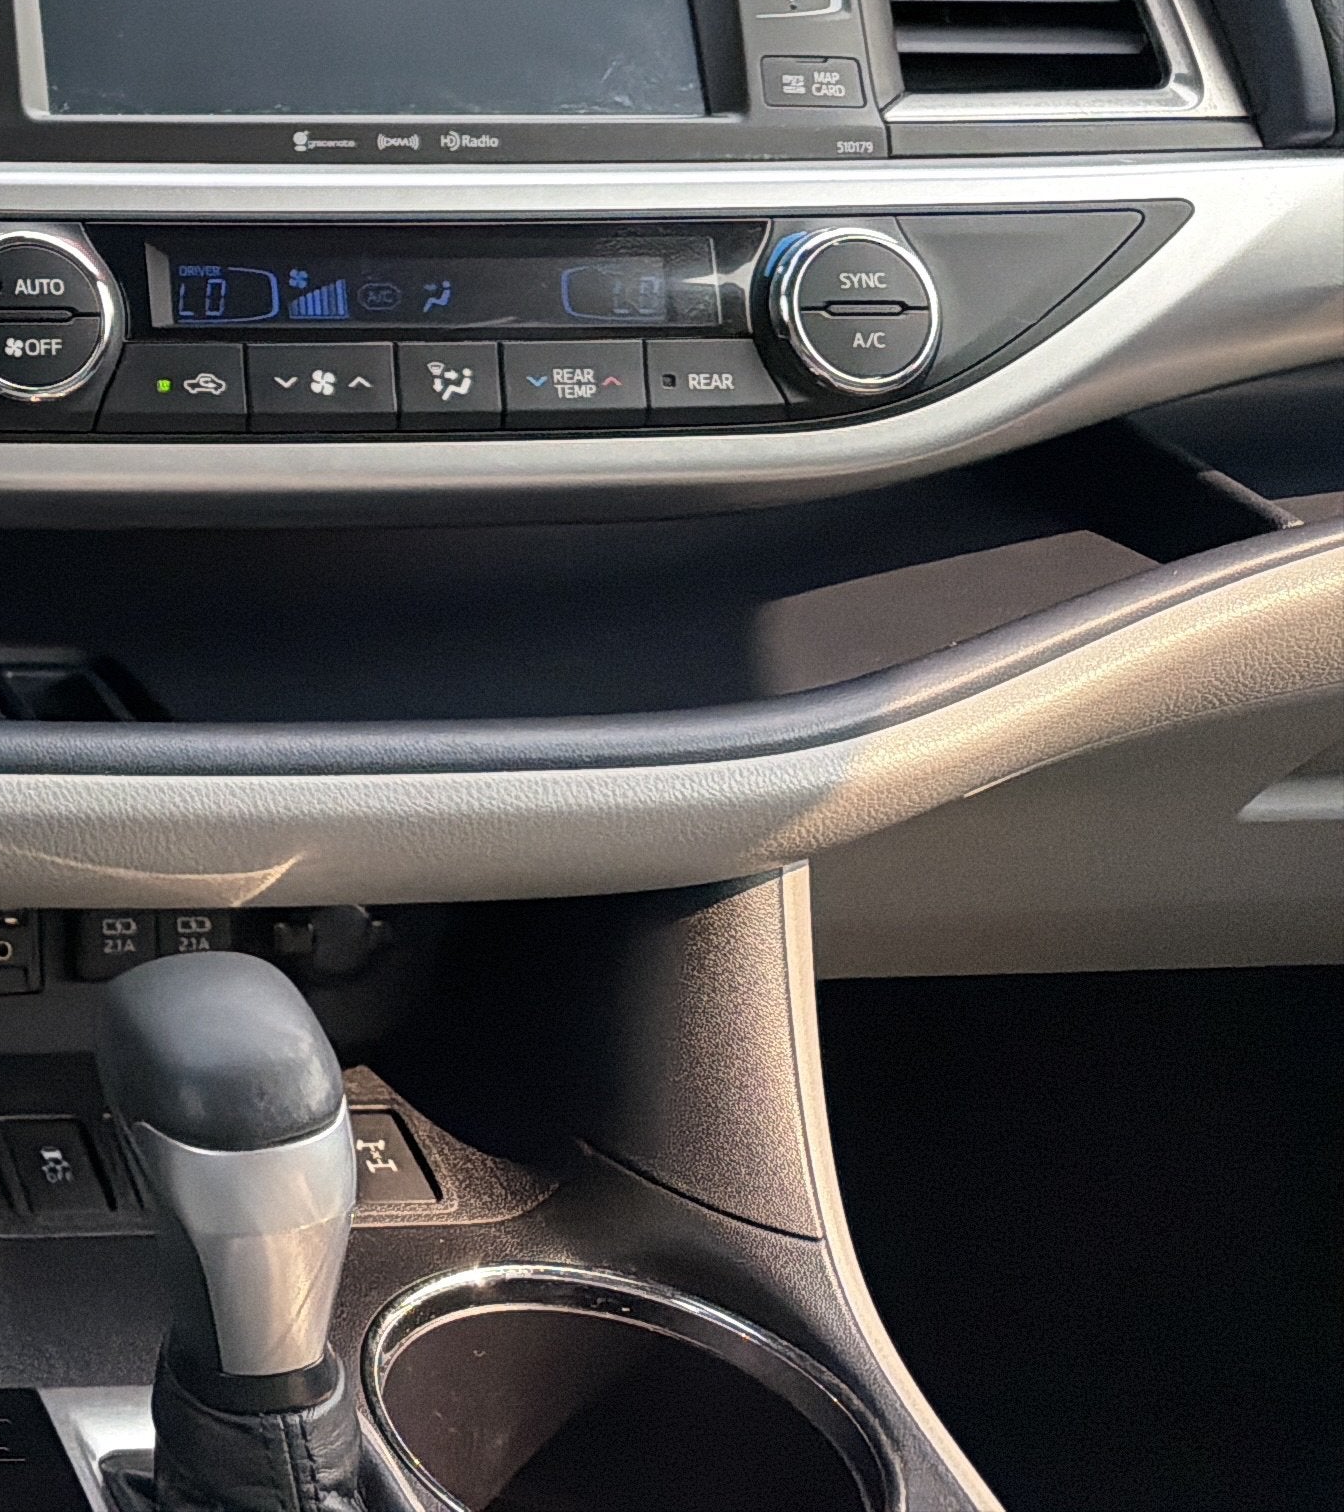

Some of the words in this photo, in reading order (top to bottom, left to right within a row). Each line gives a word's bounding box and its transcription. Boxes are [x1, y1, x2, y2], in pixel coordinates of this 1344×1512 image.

[813, 71, 840, 83] MAP
[812, 84, 846, 97] CARD
[462, 135, 499, 147] Radio
[179, 266, 221, 276] DRIVER
[14, 279, 64, 296] AUTO
[839, 272, 886, 289] SYNC
[24, 339, 63, 356] OFF
[853, 332, 885, 349] A/C
[553, 369, 594, 384] REAR
[688, 374, 734, 390] REAR
[554, 384, 596, 398] TEMP
